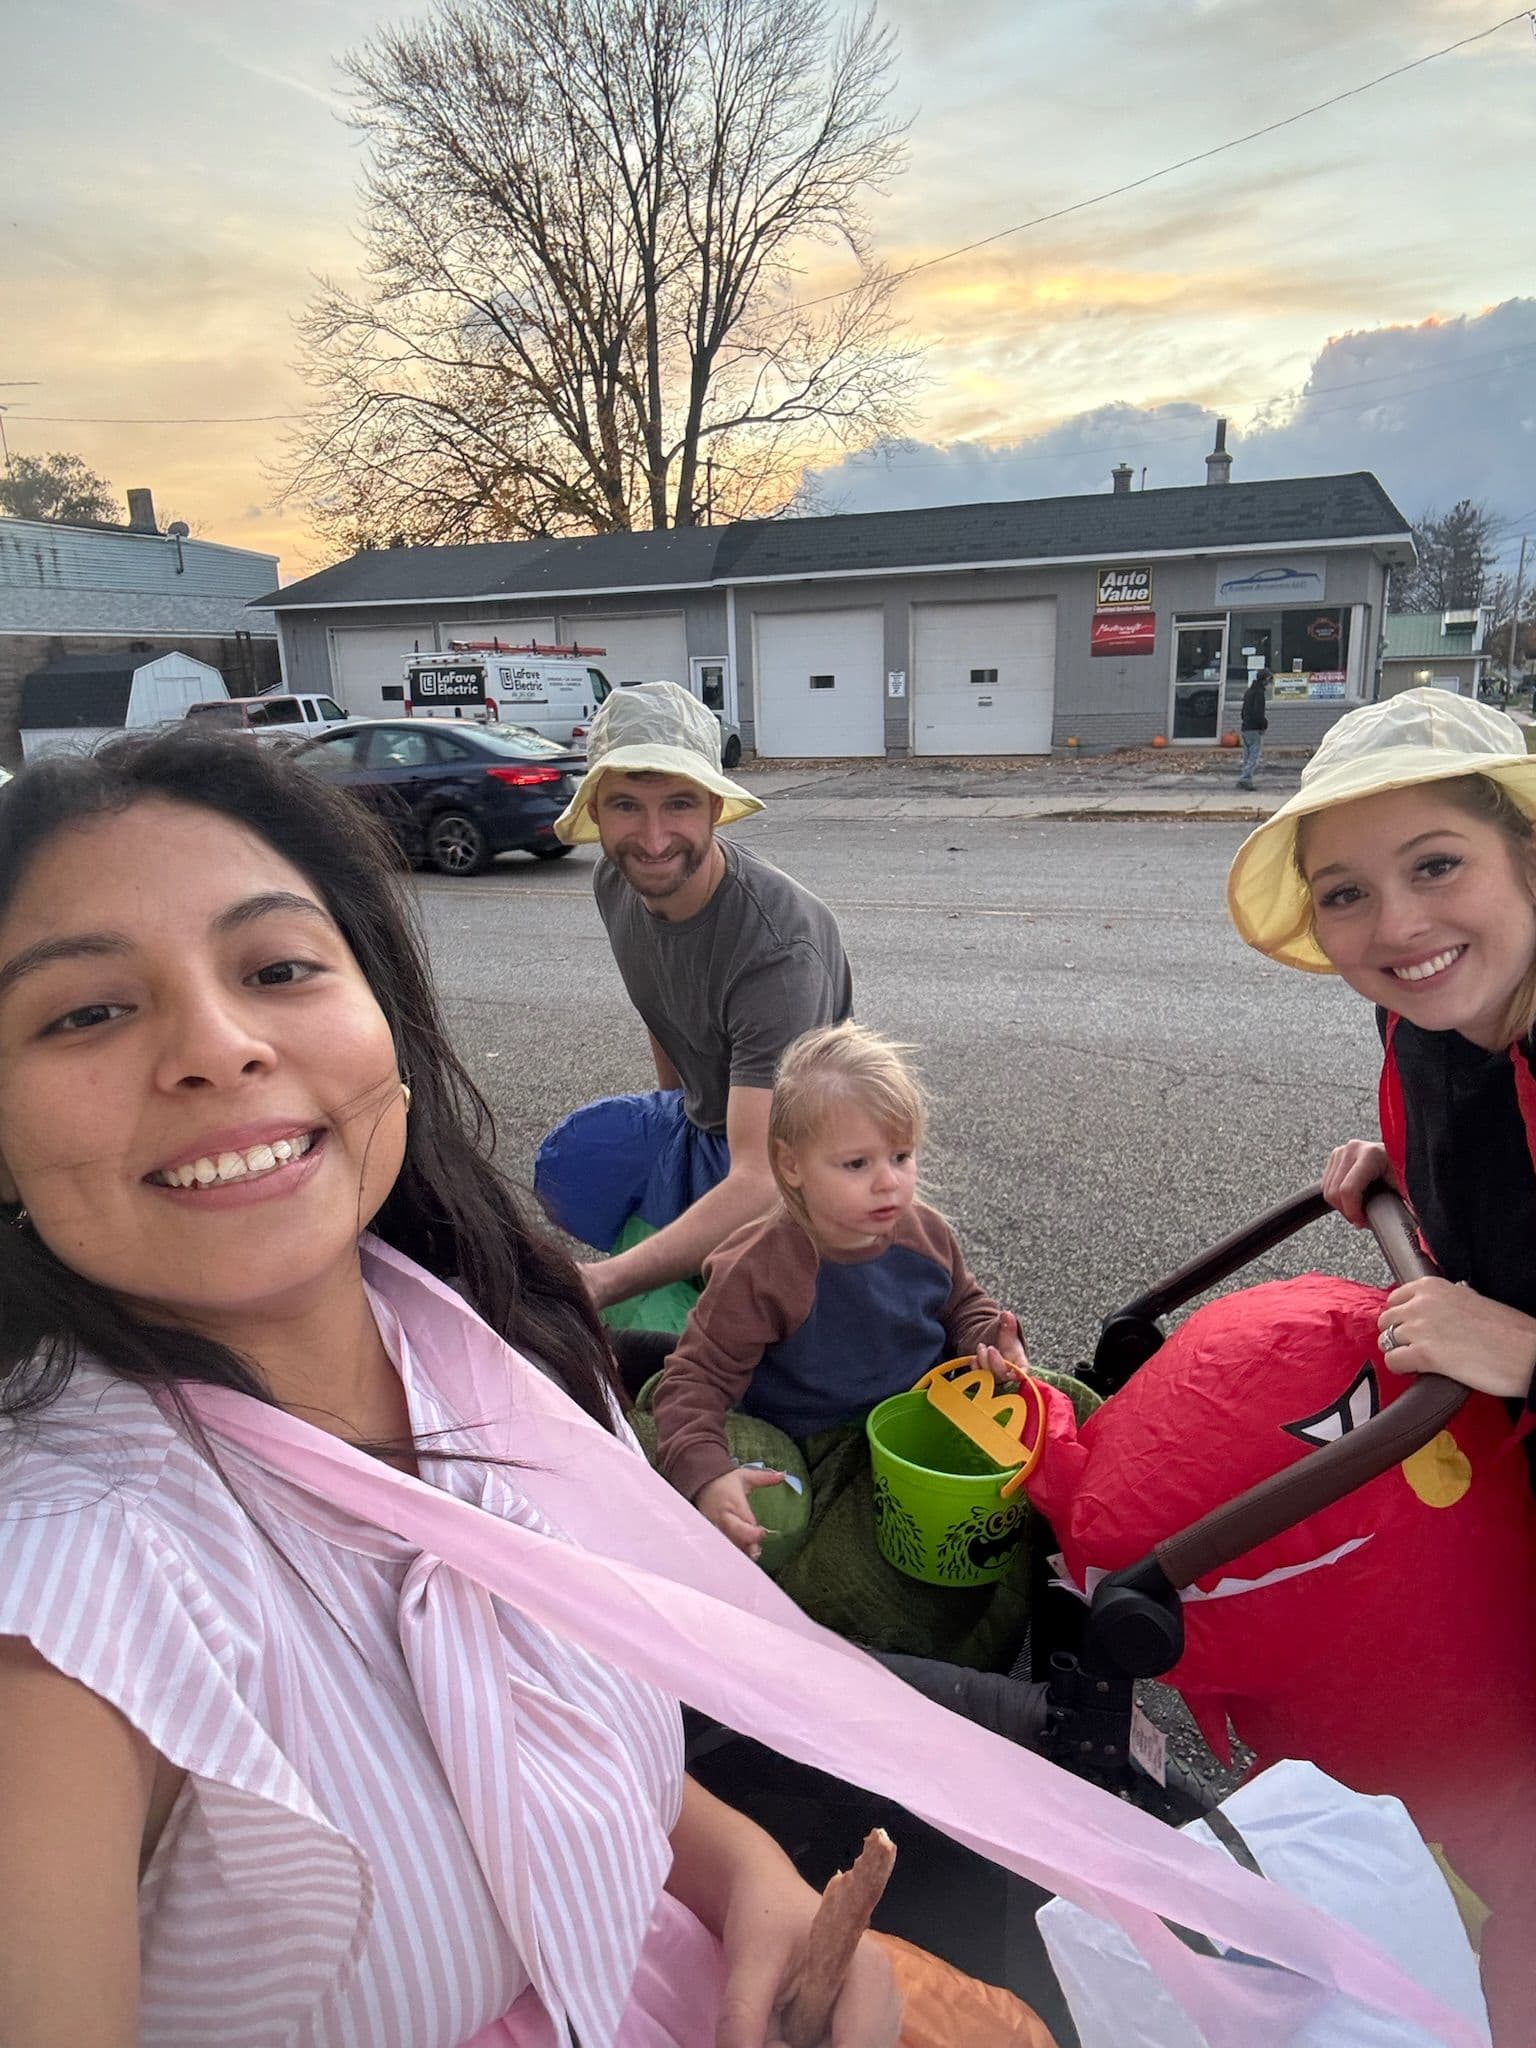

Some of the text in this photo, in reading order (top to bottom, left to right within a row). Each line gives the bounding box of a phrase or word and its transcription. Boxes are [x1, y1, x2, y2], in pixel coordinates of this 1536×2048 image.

[1102, 571, 1147, 587] Auto
[1100, 586, 1149, 602] Value
[437, 671, 477, 683] LaFave
[512, 668, 540, 679] LaFave
[438, 683, 479, 695] Electric
[514, 680, 543, 691] Electric
